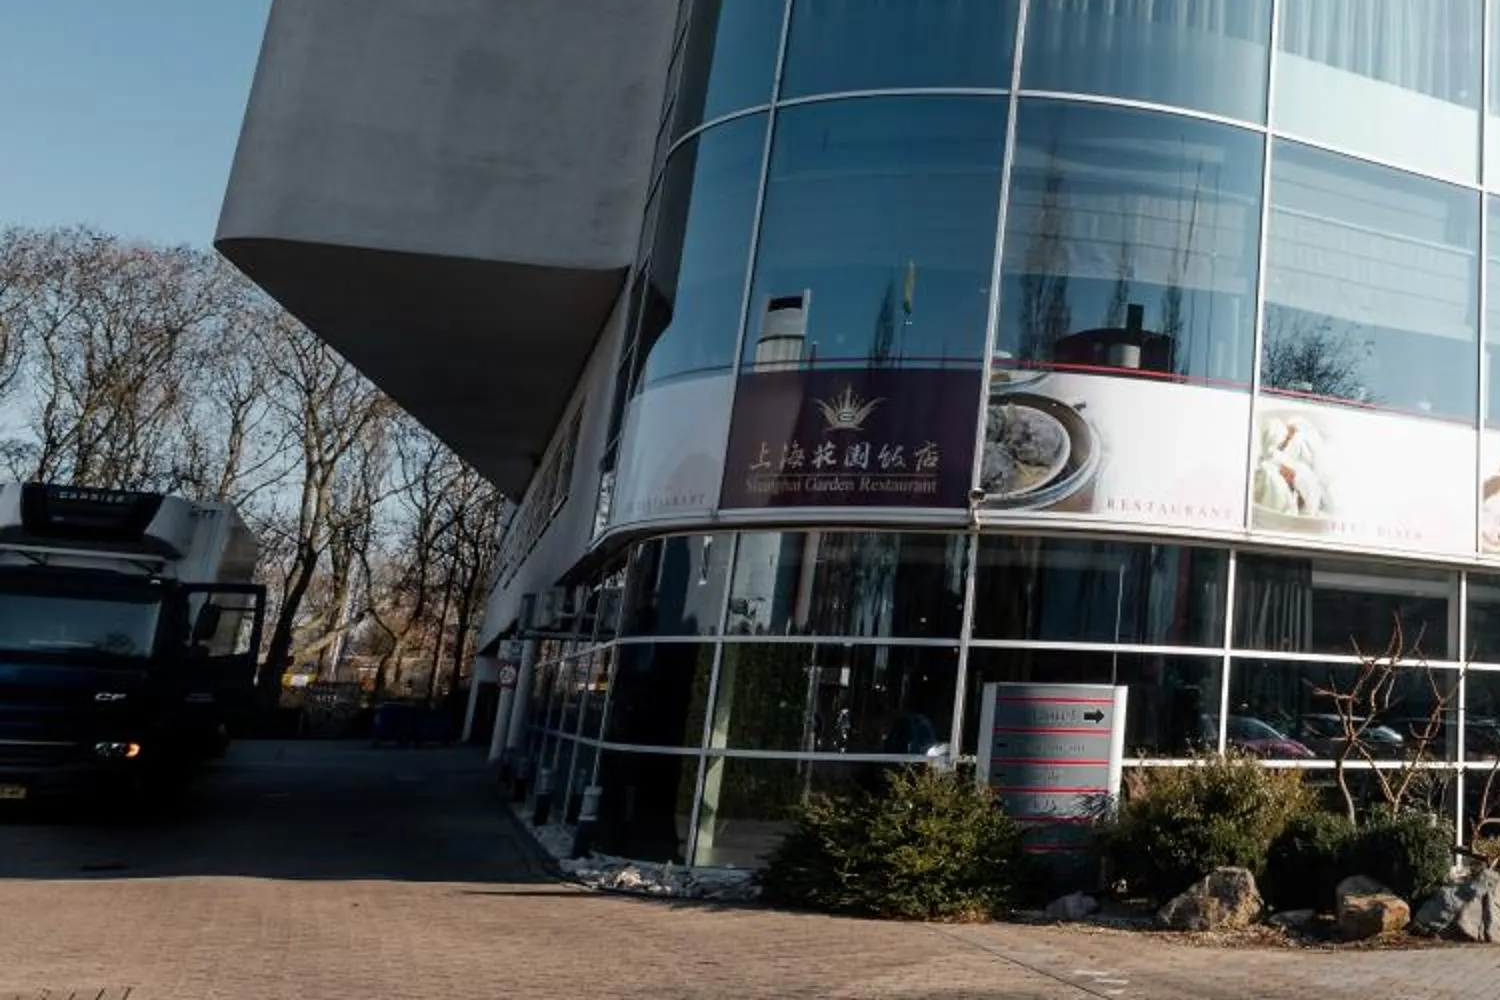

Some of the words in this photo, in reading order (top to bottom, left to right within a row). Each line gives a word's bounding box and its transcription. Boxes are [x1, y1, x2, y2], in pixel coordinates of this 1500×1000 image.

[805, 476, 855, 493] Garden
[859, 477, 937, 494] Restaurant
[1107, 498, 1232, 518] RESTAURANT
